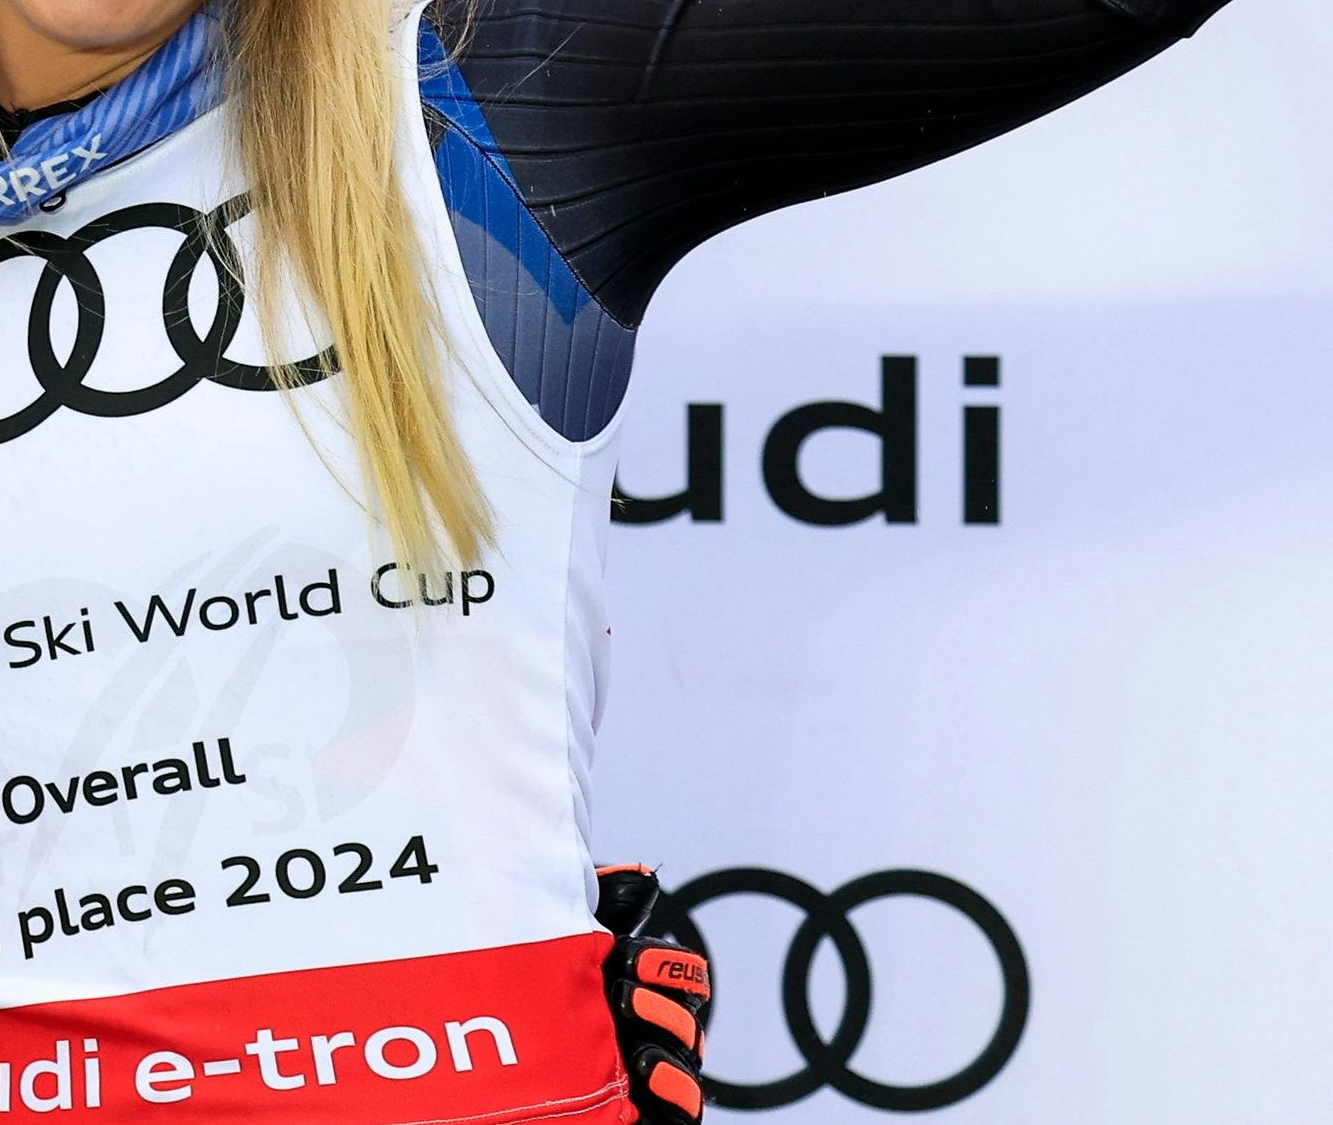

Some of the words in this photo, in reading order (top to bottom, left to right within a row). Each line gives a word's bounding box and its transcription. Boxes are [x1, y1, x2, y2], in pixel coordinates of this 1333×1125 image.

[609, 355, 1002, 526] udi
[3, 606, 96, 670] Ski
[113, 568, 343, 643] World
[370, 562, 496, 617] Cup
[0, 736, 247, 826] Overall
[18, 877, 197, 960] place
[221, 834, 440, 909] 2024
[134, 1015, 519, 1104] e-tron
